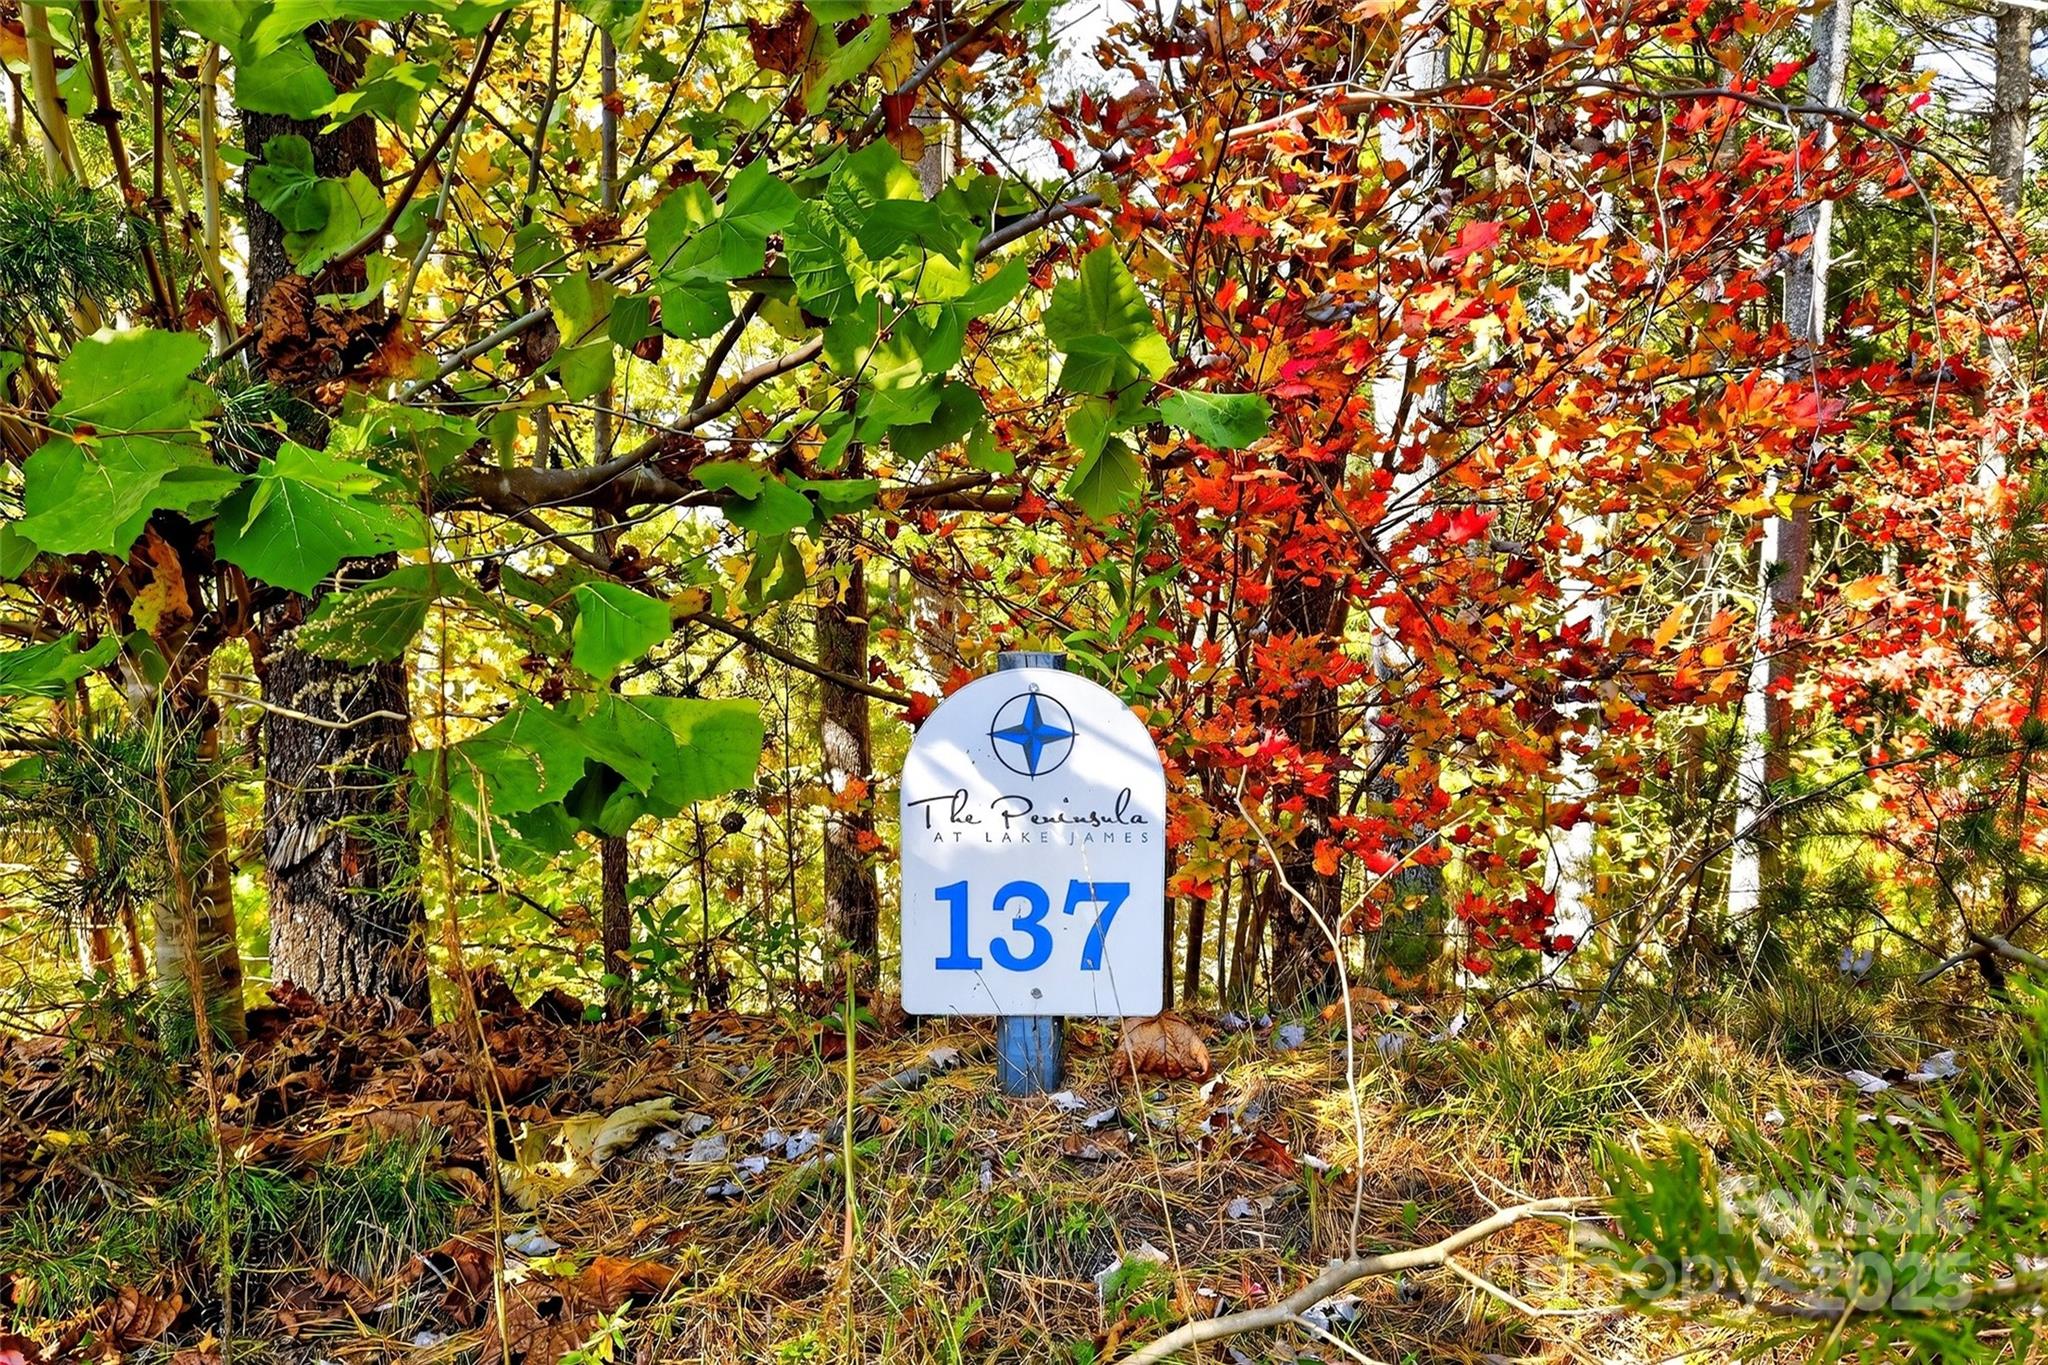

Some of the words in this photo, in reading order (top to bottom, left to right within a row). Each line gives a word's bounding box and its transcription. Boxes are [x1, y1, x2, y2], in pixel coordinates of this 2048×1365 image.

[907, 789, 981, 829] The
[991, 787, 1149, 829] Peninsula
[933, 831, 962, 843] AT
[985, 831, 1049, 843] LAKE
[1069, 831, 1150, 845] JAMES
[934, 879, 1131, 972] 137
